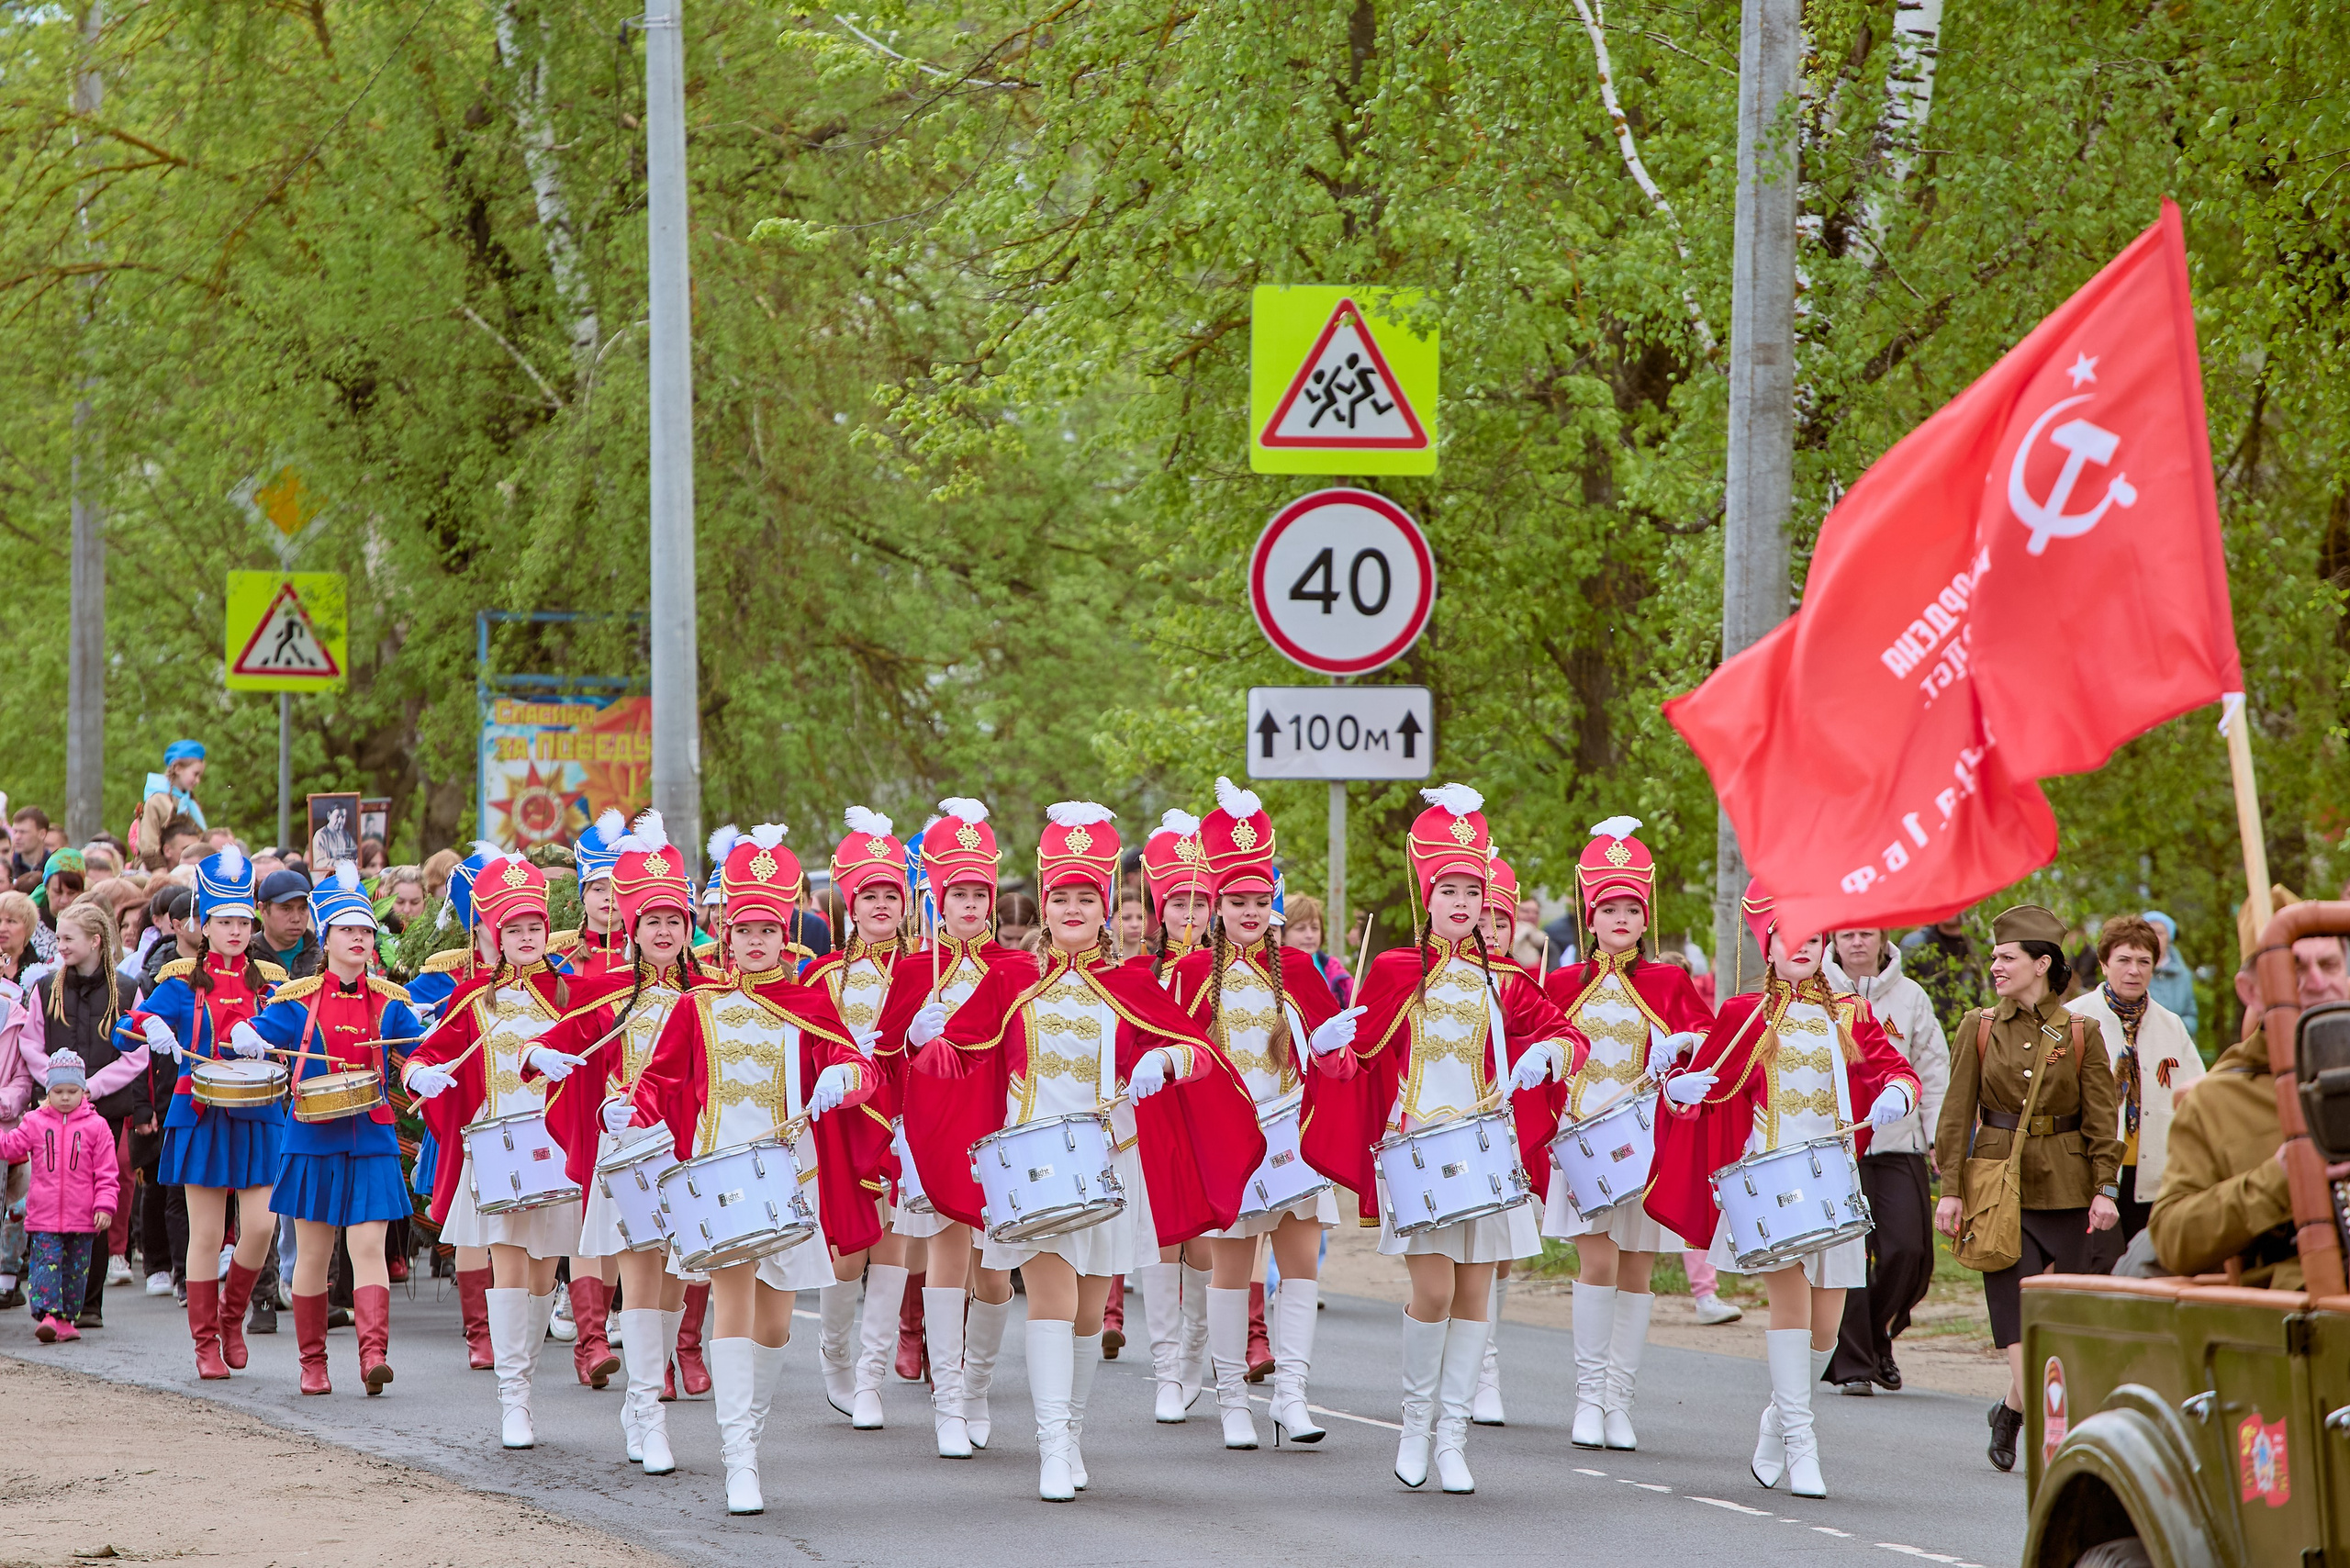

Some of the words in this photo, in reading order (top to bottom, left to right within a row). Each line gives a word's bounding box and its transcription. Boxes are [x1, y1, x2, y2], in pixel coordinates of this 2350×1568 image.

[1289, 547, 1391, 616] 40
[535, 732, 651, 763] ПОБЕДУ
[1444, 1164, 1464, 1175] Flight
[721, 1193, 740, 1204] Flight
[1779, 1193, 1799, 1204] Flight
